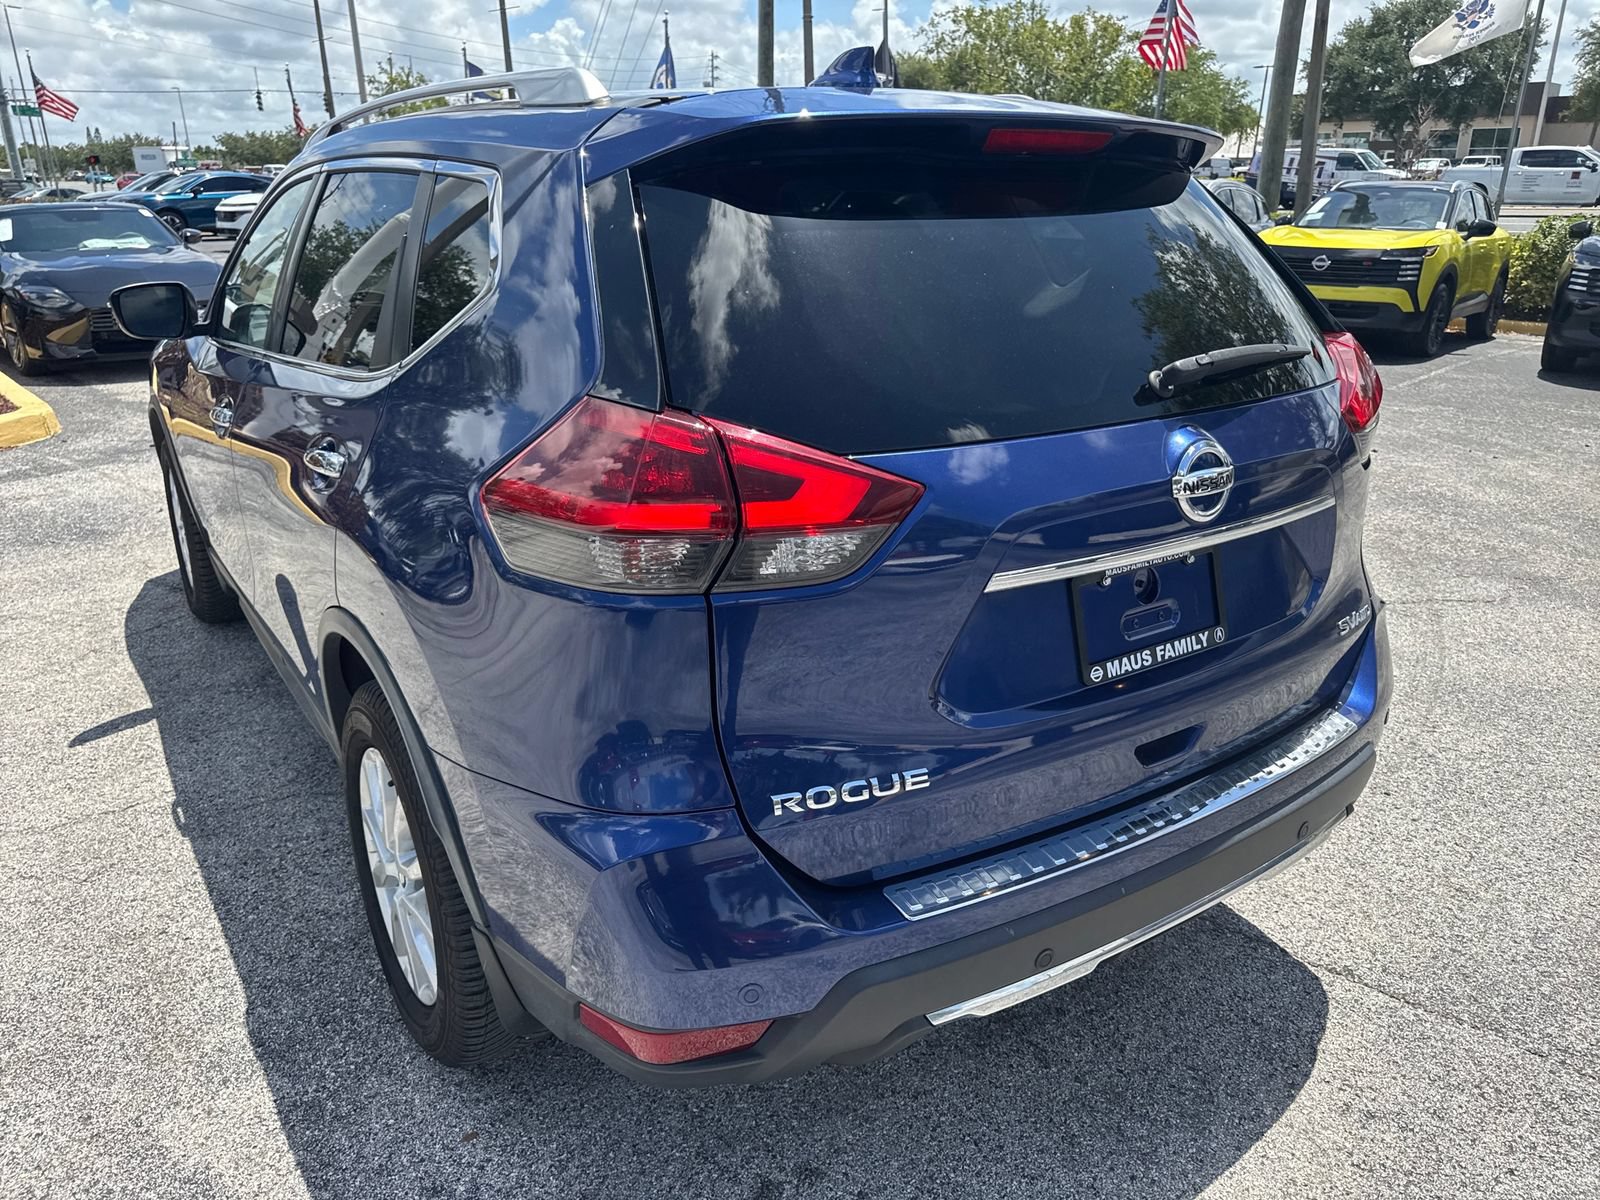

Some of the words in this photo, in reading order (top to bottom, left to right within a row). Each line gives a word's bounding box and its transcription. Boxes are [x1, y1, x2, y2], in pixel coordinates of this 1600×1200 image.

[1182, 473, 1233, 494] NISSAN
[1106, 649, 1153, 678] MAUS
[1155, 631, 1209, 662] FAMILY
[770, 767, 931, 817] ROGUE
